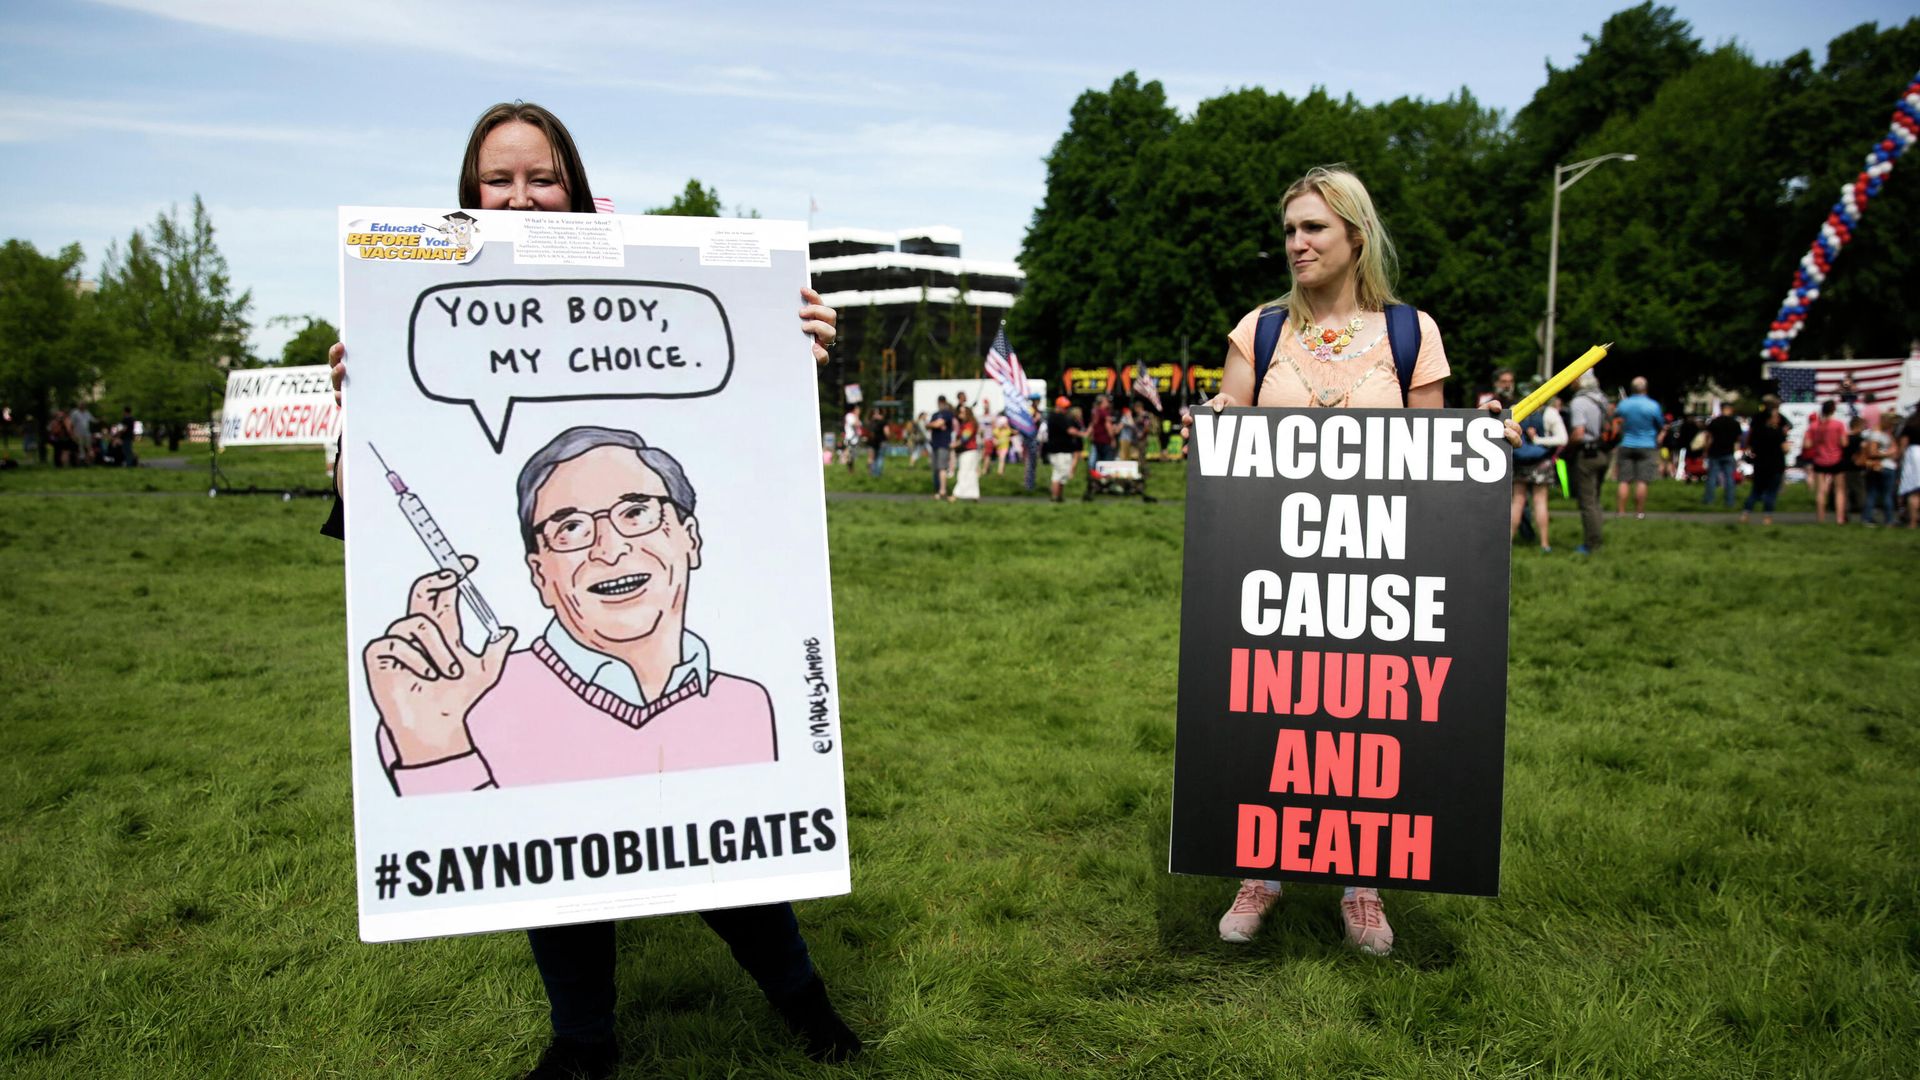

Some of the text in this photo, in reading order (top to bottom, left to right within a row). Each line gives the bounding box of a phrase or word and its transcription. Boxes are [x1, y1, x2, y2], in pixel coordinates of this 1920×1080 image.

[346, 233, 449, 247] BEFORE You
[359, 247, 467, 260] VACCINATE
[370, 222, 426, 233] Educate
[435, 296, 669, 333] YOUR BODY,
[489, 345, 702, 374] MY CHOICE.
[1194, 414, 1508, 484] VACCINES
[1280, 492, 1407, 560] CAN
[1240, 569, 1446, 643] CAUSE
[1228, 648, 1453, 722] INJURY
[1268, 728, 1400, 800] AND
[375, 807, 837, 900] #SAYNOTOBILLGATES
[1236, 803, 1433, 881] DEATH
